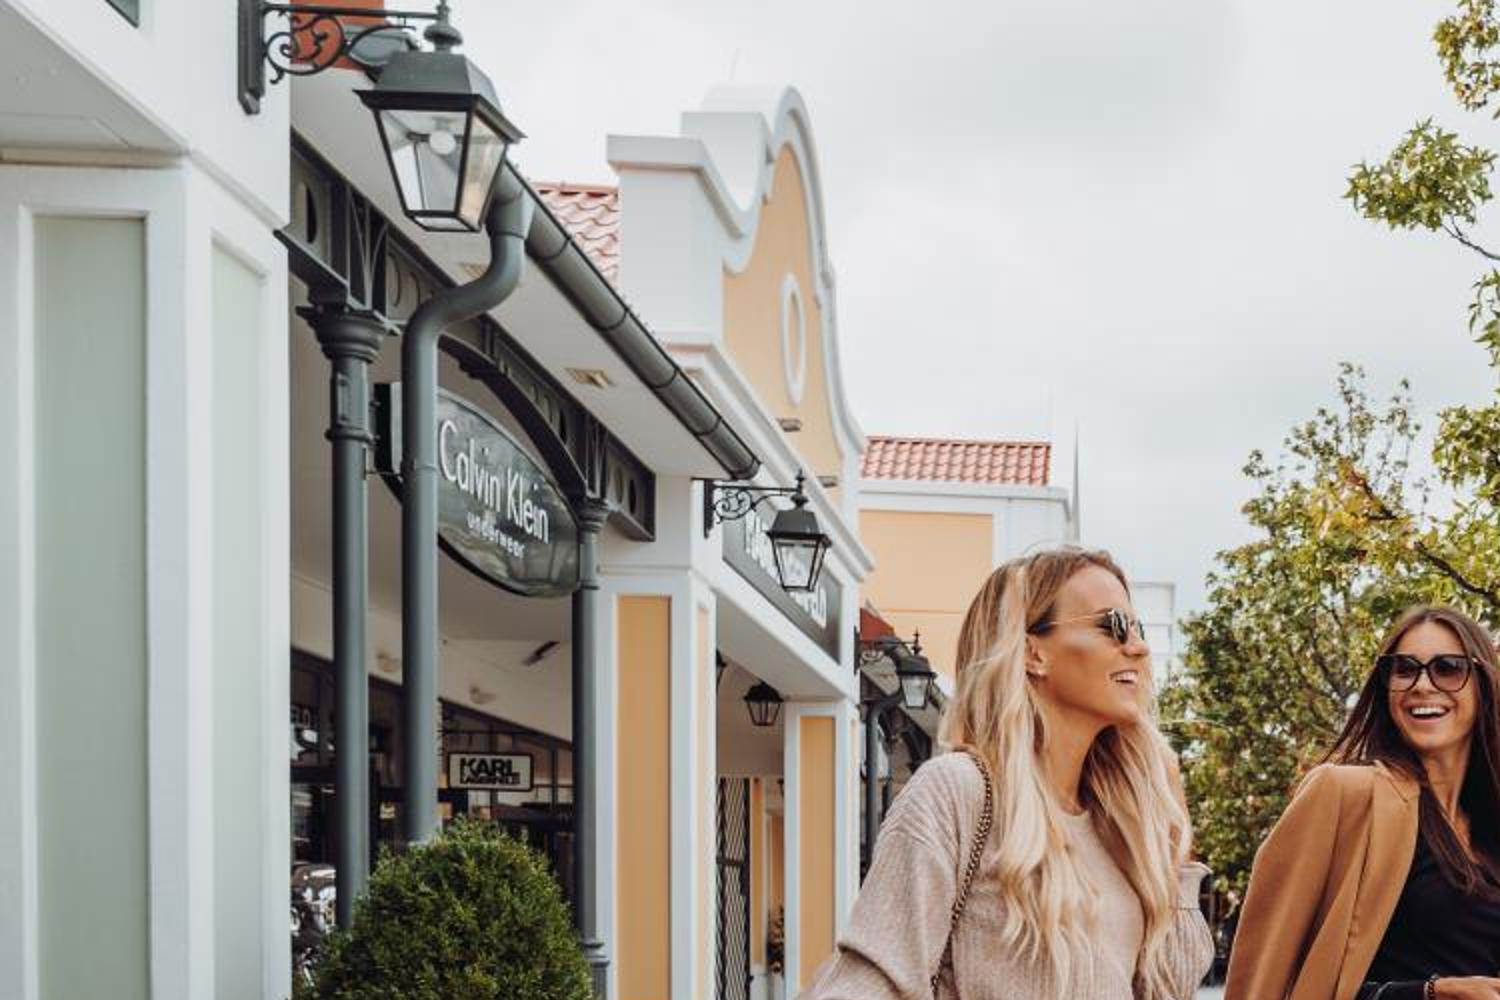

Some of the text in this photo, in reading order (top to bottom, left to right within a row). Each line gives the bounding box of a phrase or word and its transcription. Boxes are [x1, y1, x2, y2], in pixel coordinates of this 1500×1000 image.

[440, 419, 549, 544] Calvin Klein
[460, 757, 520, 778] KARL
